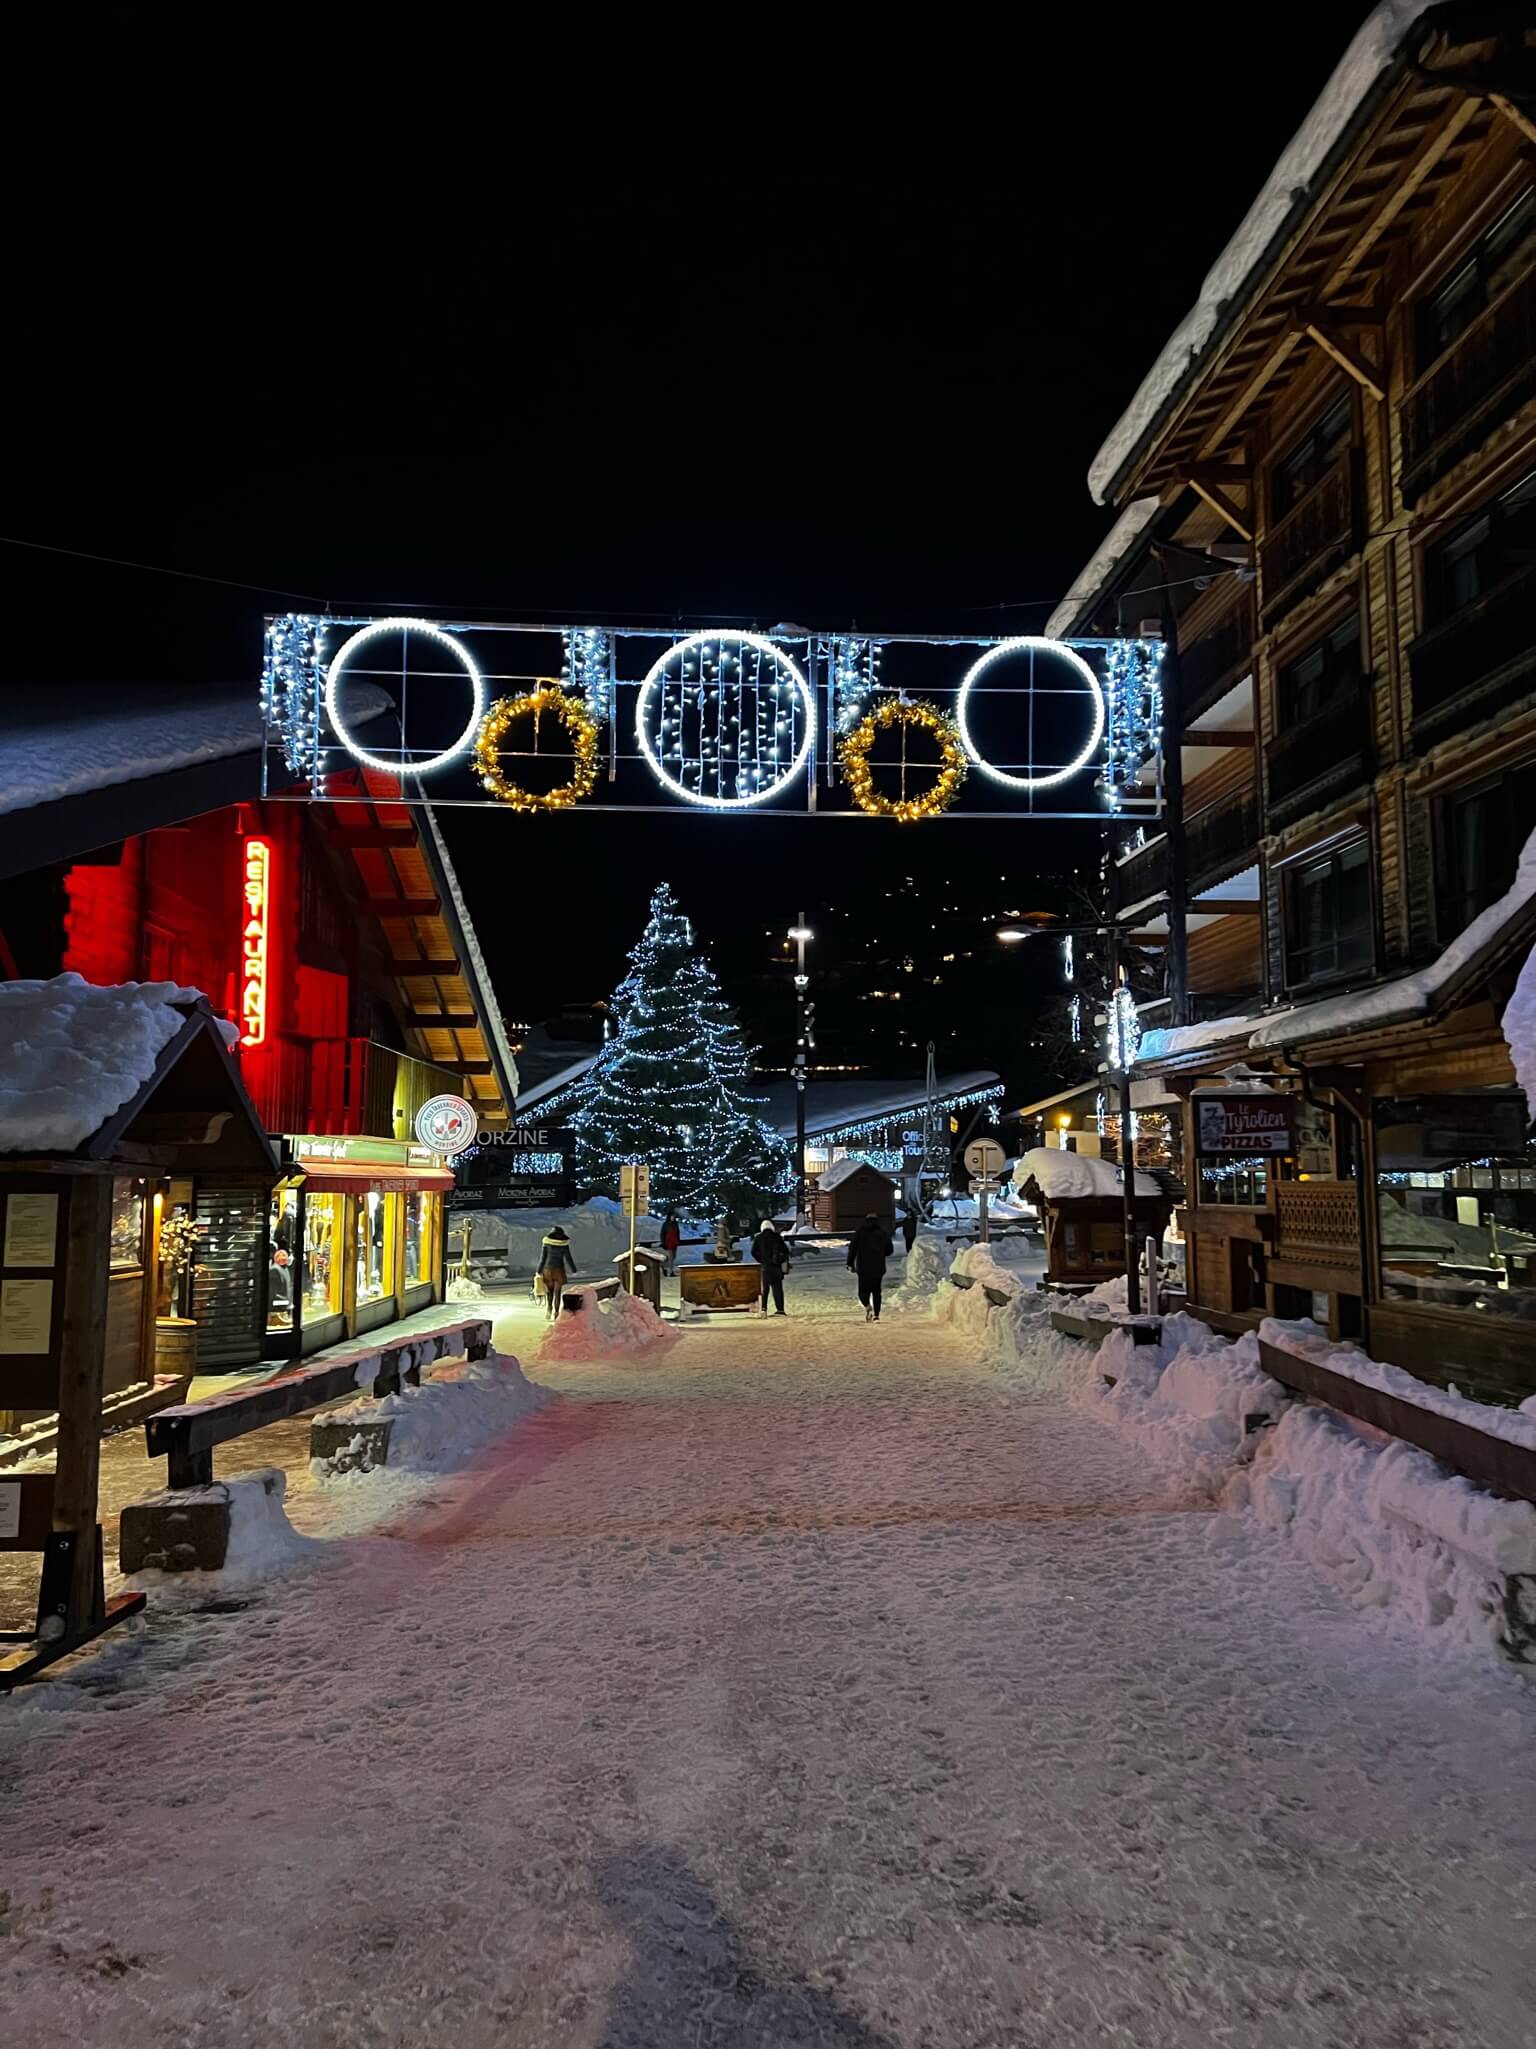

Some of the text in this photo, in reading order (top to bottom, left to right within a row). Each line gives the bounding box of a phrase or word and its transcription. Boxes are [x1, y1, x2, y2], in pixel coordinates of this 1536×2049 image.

[243, 840, 267, 1035] RESTAURANT
[1226, 1109, 1287, 1133] Tyrolien
[472, 1129, 549, 1145] ORZINE
[1221, 1135, 1273, 1149] PIZZAS
